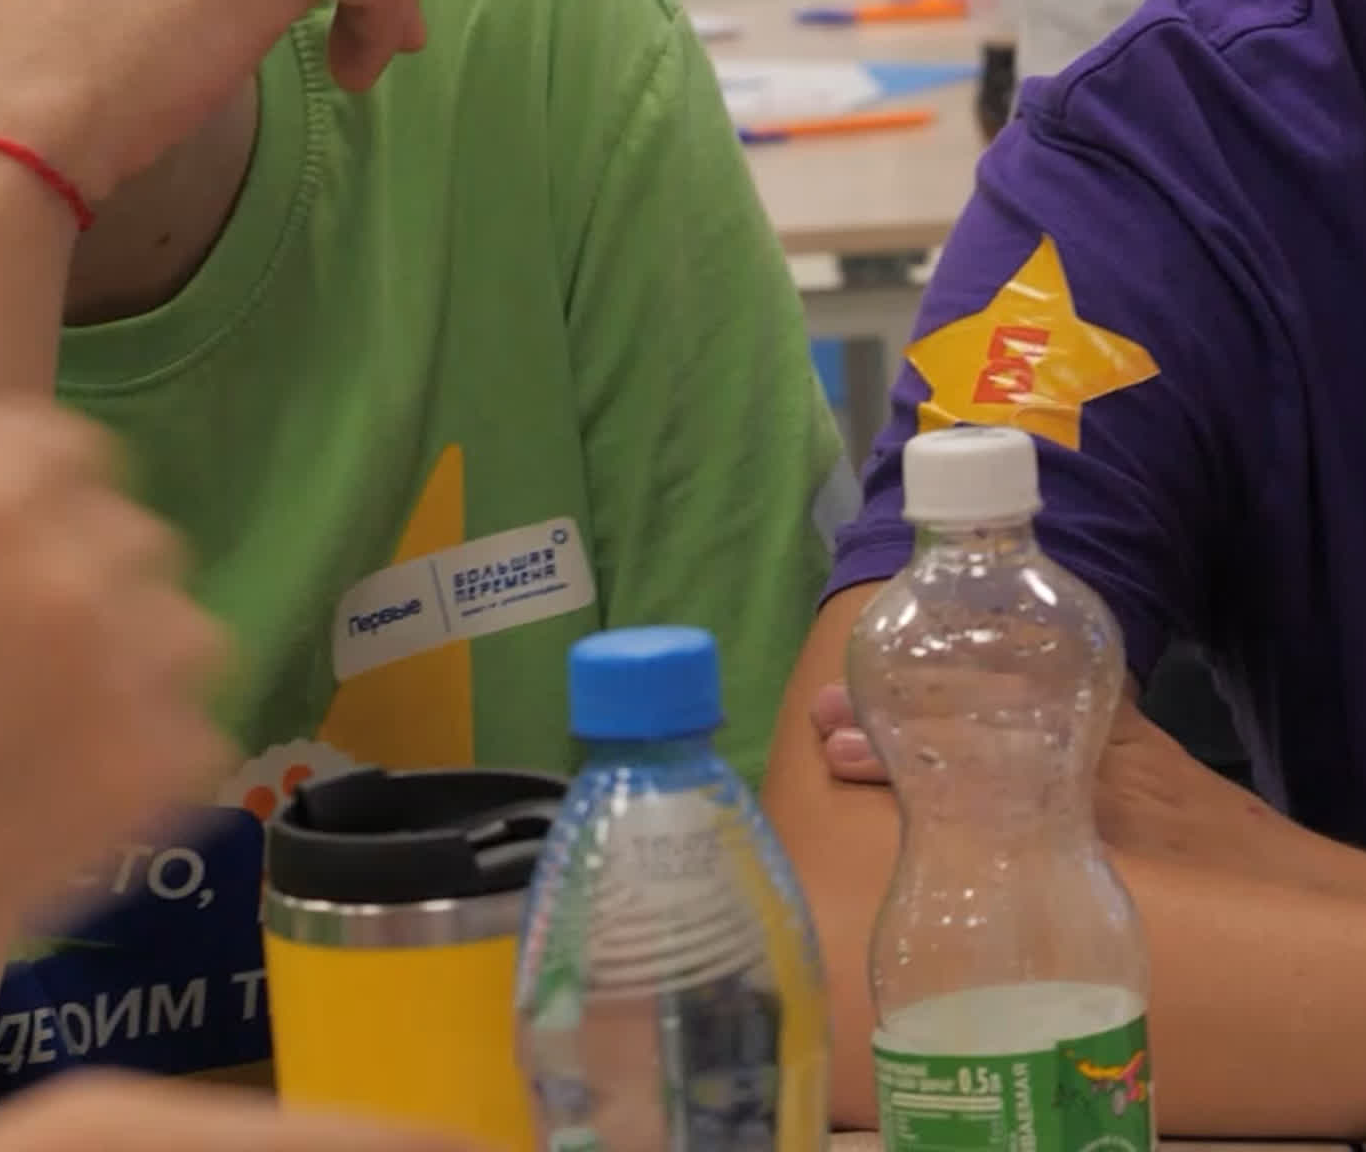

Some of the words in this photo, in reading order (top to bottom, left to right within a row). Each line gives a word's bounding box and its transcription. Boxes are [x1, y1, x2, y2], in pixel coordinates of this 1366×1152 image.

[453, 547, 555, 590] БОЛЬШАЯ
[453, 563, 556, 605] ПЕРЕМЕНА
[348, 598, 422, 638] Первые
